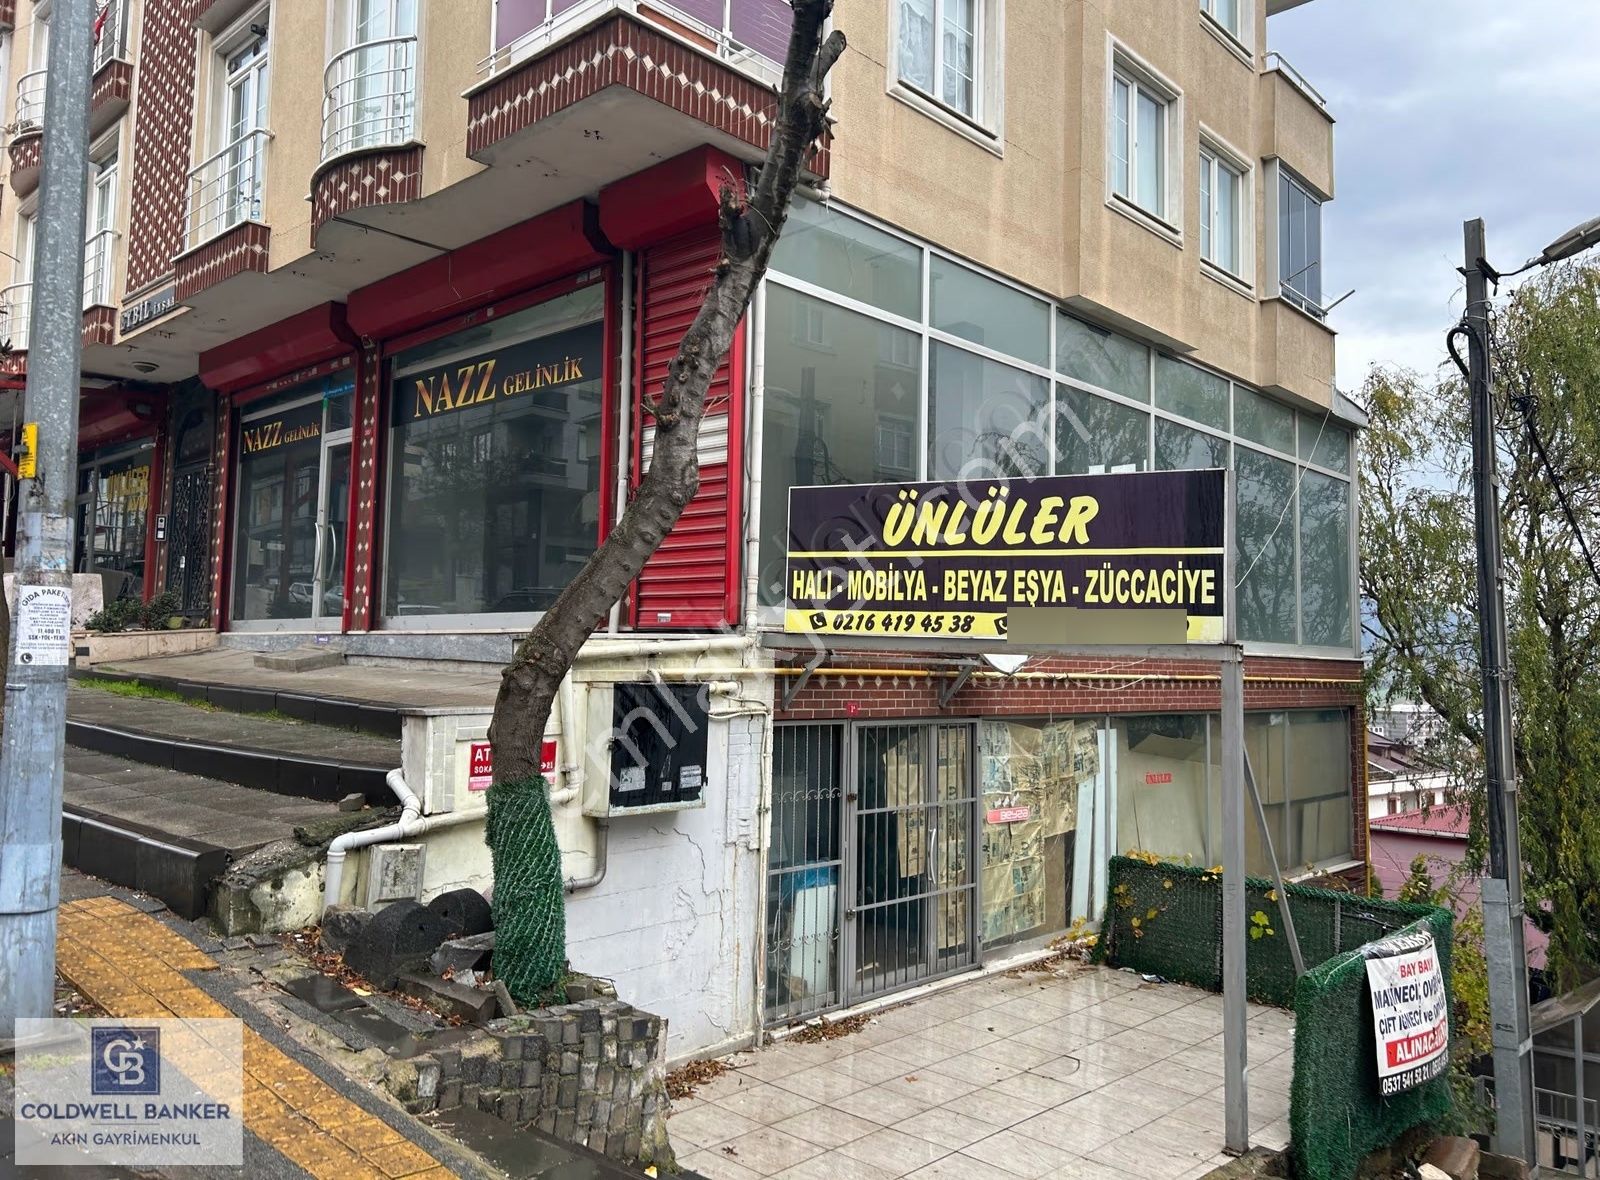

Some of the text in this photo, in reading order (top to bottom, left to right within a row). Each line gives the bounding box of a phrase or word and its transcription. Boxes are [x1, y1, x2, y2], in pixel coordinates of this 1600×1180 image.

[414, 356, 583, 418] NAZZ GELİNLİK
[243, 421, 320, 454] NAZZ GELİNLİK
[883, 486, 1099, 546] ÜNLÜLER
[792, 570, 832, 600] HALI
[848, 563, 926, 601] MOBİLYA
[943, 571, 1007, 602] BEYAZ
[1013, 570, 1066, 607] EŞYA
[1085, 560, 1216, 604] ZÜCCACİYE
[22, 591, 40, 606] GIDA
[833, 613, 975, 634] 0216 419 45 38
[475, 748, 491, 762] AT
[474, 765, 492, 774] SOKA
[1400, 962, 1416, 979] BAY
[1379, 1014, 1397, 1040] ÇİFT
[1424, 1011, 1433, 1023] ve
[1383, 1075, 1401, 1094] 0537
